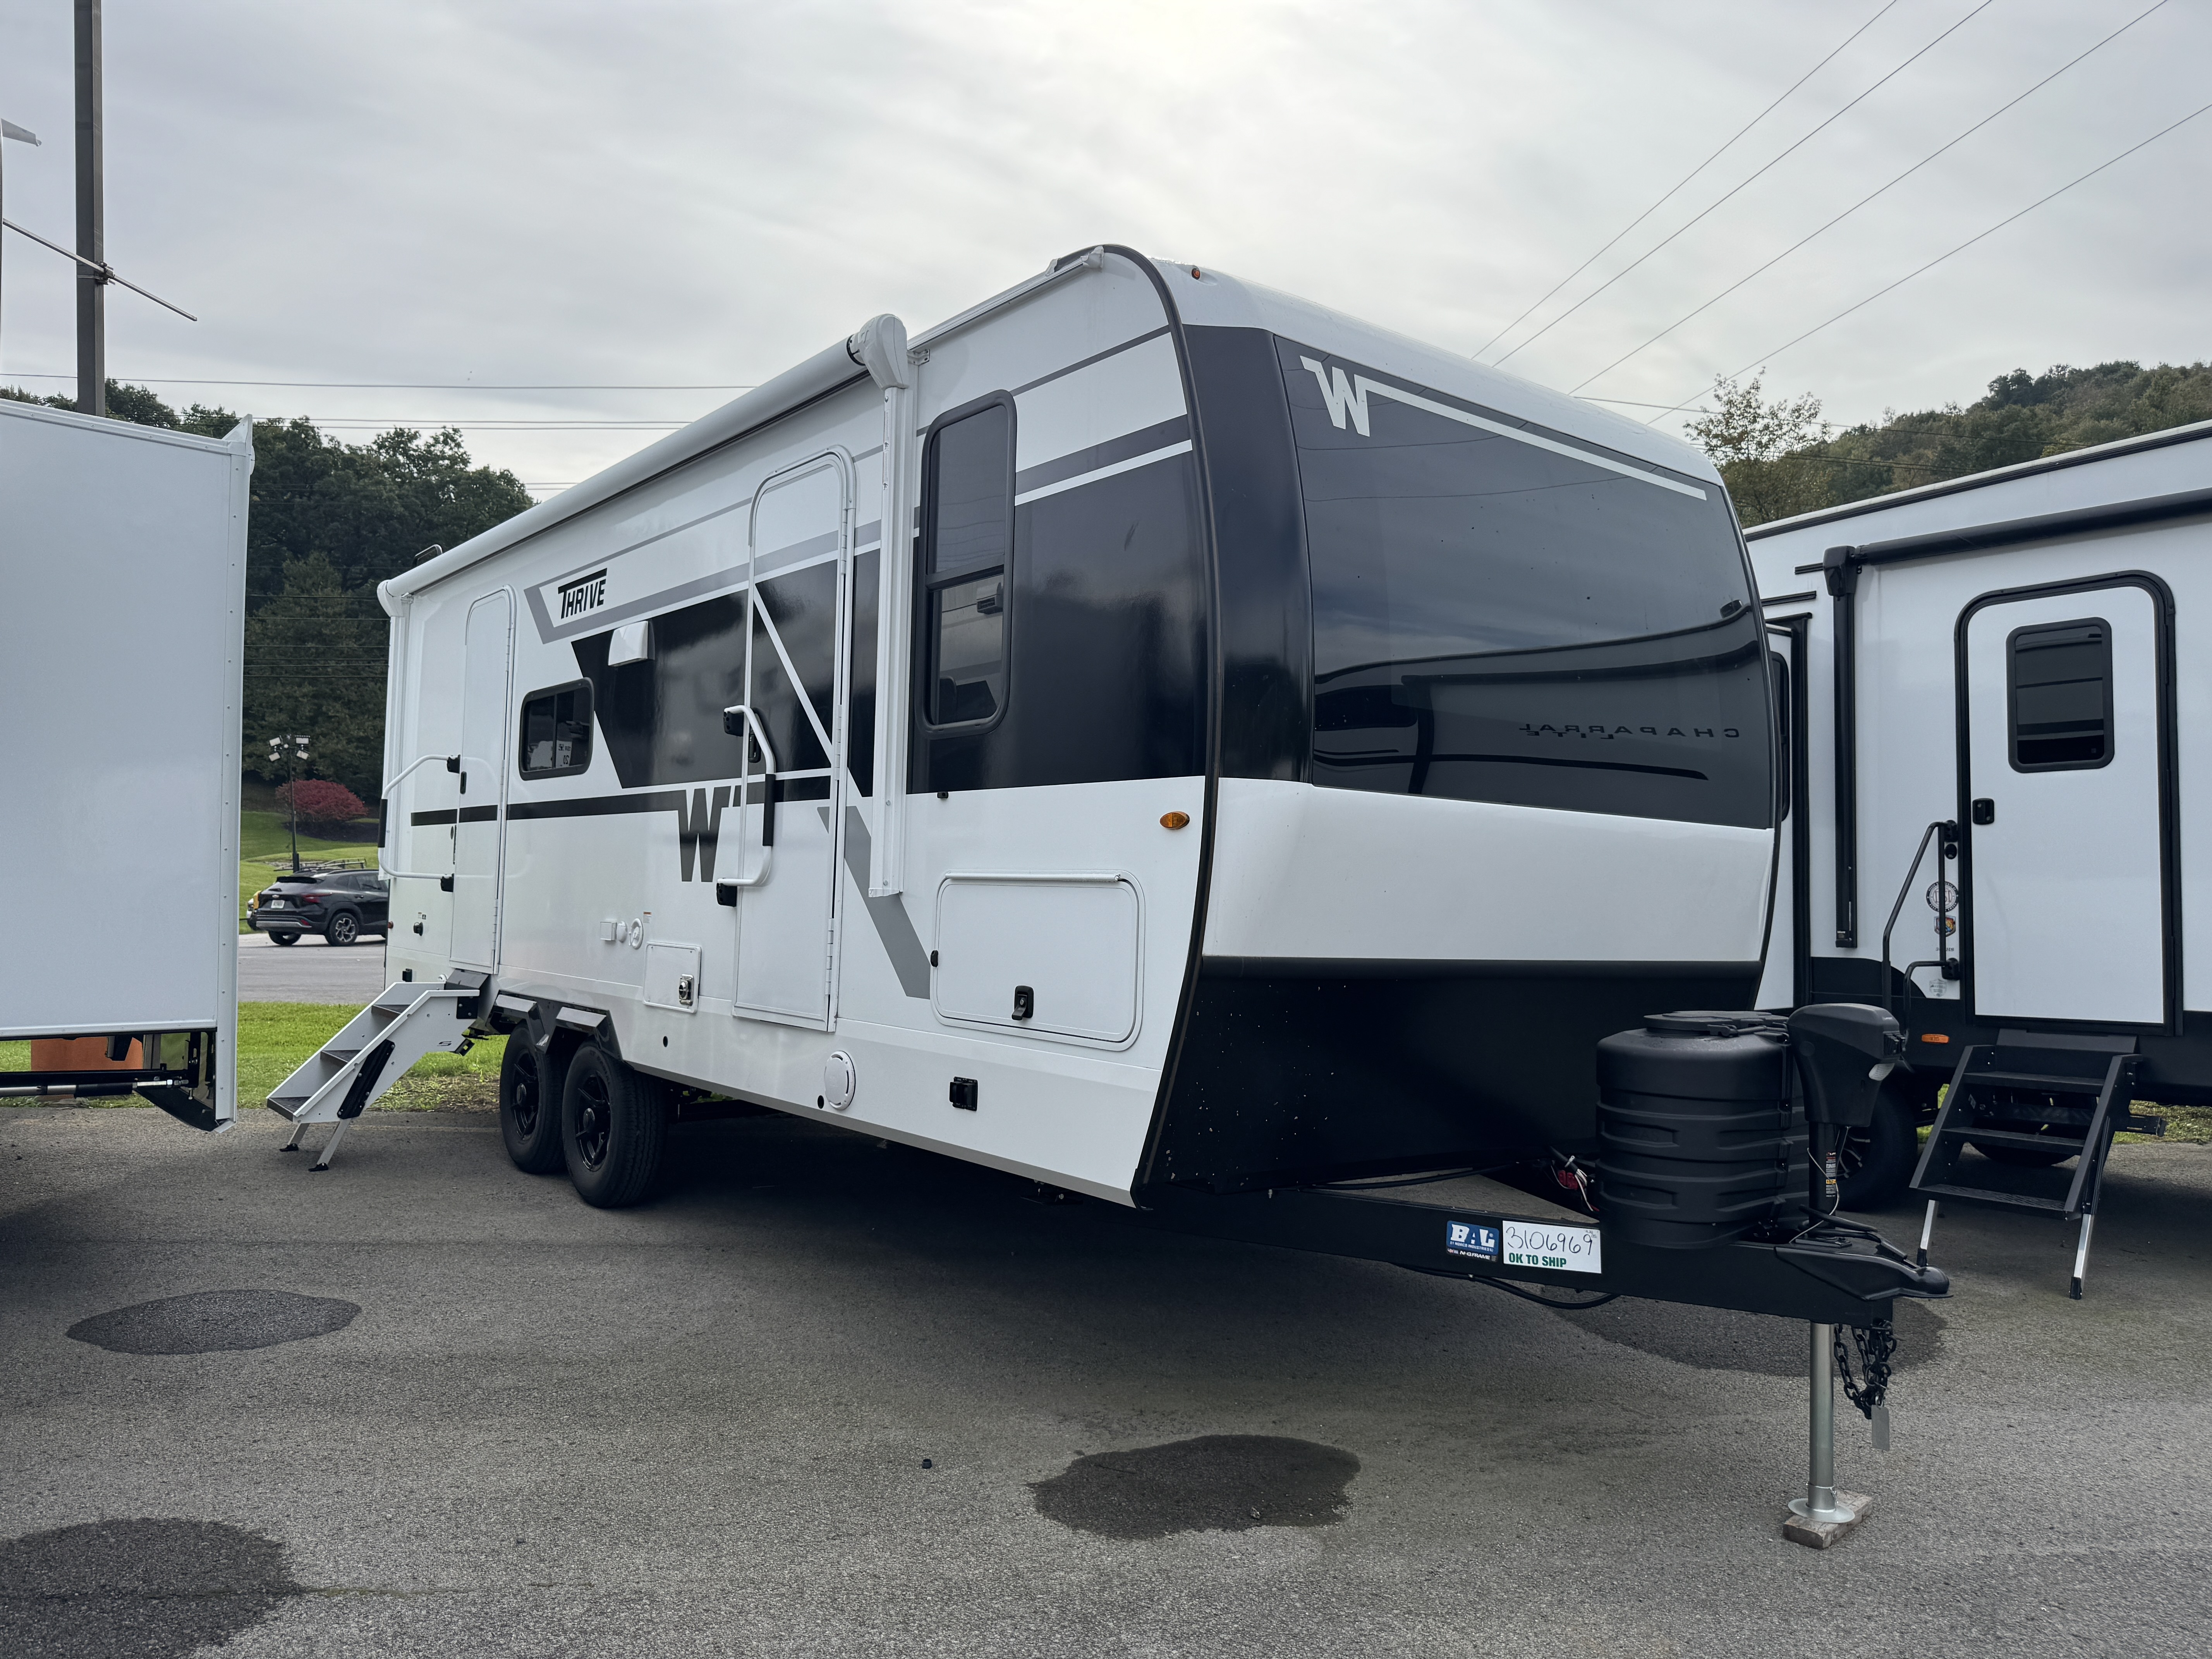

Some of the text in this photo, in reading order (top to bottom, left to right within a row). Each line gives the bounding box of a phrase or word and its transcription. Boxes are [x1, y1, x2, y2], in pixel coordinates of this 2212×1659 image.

[558, 568, 608, 619] THRIVE
[1451, 1224, 1495, 1248] BAL
[1506, 1226, 1592, 1255] 3106969
[1508, 1252, 1523, 1264] OK
[1526, 1254, 1539, 1265] TO
[1542, 1255, 1567, 1267] SHIP
